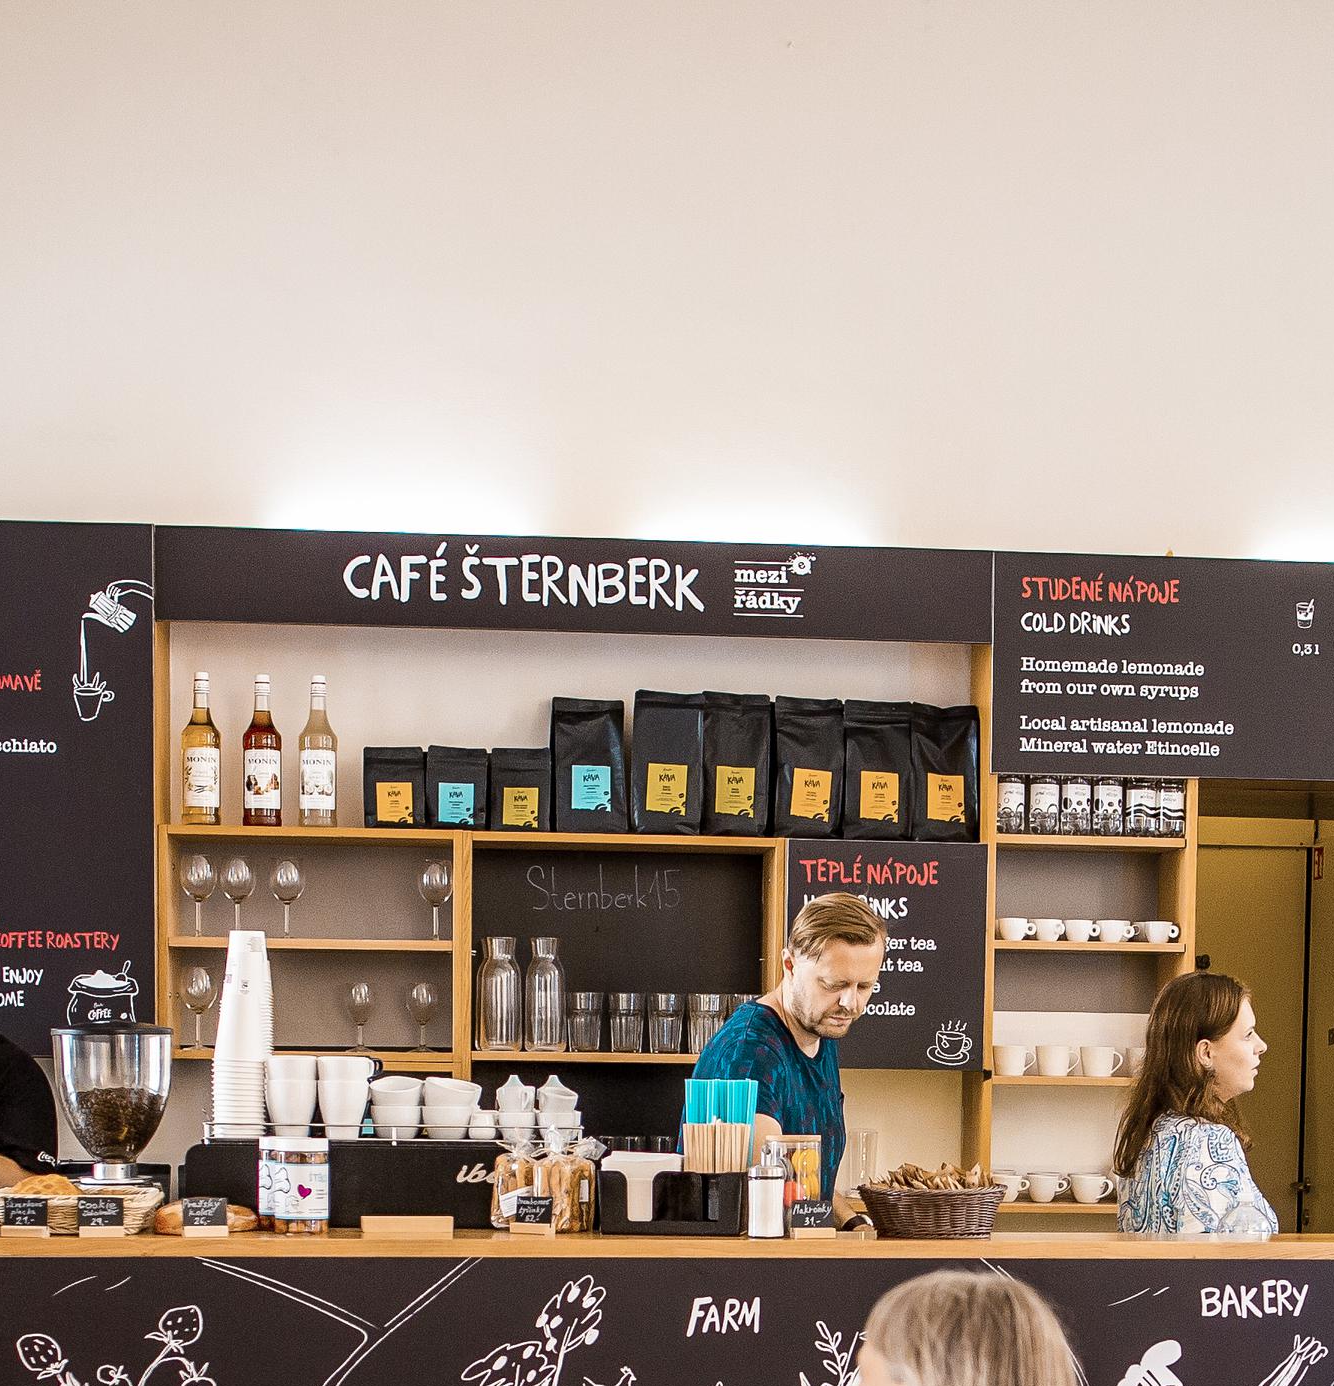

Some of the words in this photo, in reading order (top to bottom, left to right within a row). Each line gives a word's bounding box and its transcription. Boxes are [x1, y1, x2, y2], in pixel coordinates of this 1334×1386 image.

[343, 542, 447, 602] CAFÉ
[461, 544, 704, 612] ŠTERNBERK
[735, 566, 788, 583] mezi
[1022, 573, 1103, 601] STUDENÉ
[1109, 576, 1179, 604] NÁPOJE
[734, 590, 801, 613] řádky
[1021, 612, 1065, 632] COLD
[1021, 657, 1118, 673] Homemade
[1122, 660, 1204, 676] lemonade
[1021, 679, 1062, 694] from
[1067, 683, 1097, 694] our
[1101, 684, 1136, 695] own
[1140, 685, 1199, 700] syrups
[1020, 716, 1066, 730] Local
[1070, 718, 1148, 732] artisanal
[1152, 719, 1234, 735] lemonade
[1020, 738, 1088, 752] Mineral
[1091, 741, 1142, 754] water
[1145, 741, 1220, 756] Etincelle
[800, 855, 861, 883] TEPLÉ
[867, 857, 938, 886] NÁPOJE
[46, 931, 119, 950] ROASTERY
[910, 937, 936, 950] tea
[897, 958, 923, 972] tea
[3, 967, 43, 985] ENJOY
[1201, 1280, 1308, 1318] BAKERY
[687, 1297, 760, 1337] FARM
